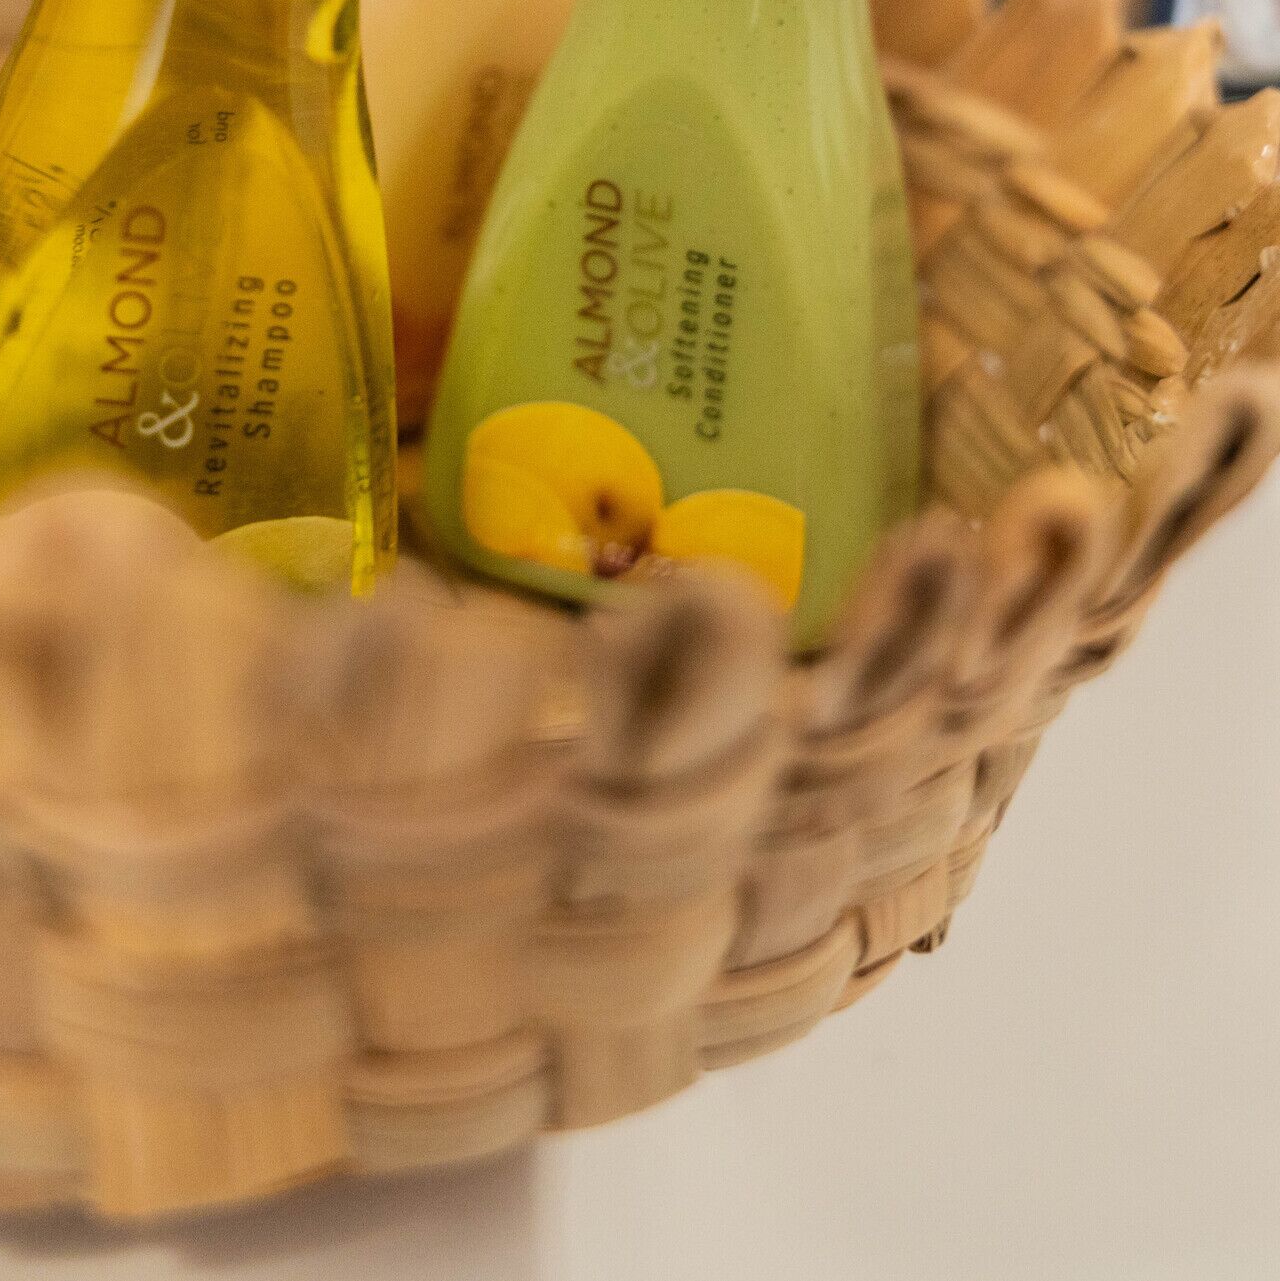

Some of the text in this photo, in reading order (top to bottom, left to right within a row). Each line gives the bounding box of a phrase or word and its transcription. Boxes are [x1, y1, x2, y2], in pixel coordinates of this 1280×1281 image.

[89, 205, 166, 449] ALMOND
[242, 279, 297, 440] Shampoo
[572, 179, 623, 387] ALMOND
[666, 248, 710, 400] Softening
[695, 255, 738, 443] Conditioner
[194, 275, 265, 497] Revitalizing
